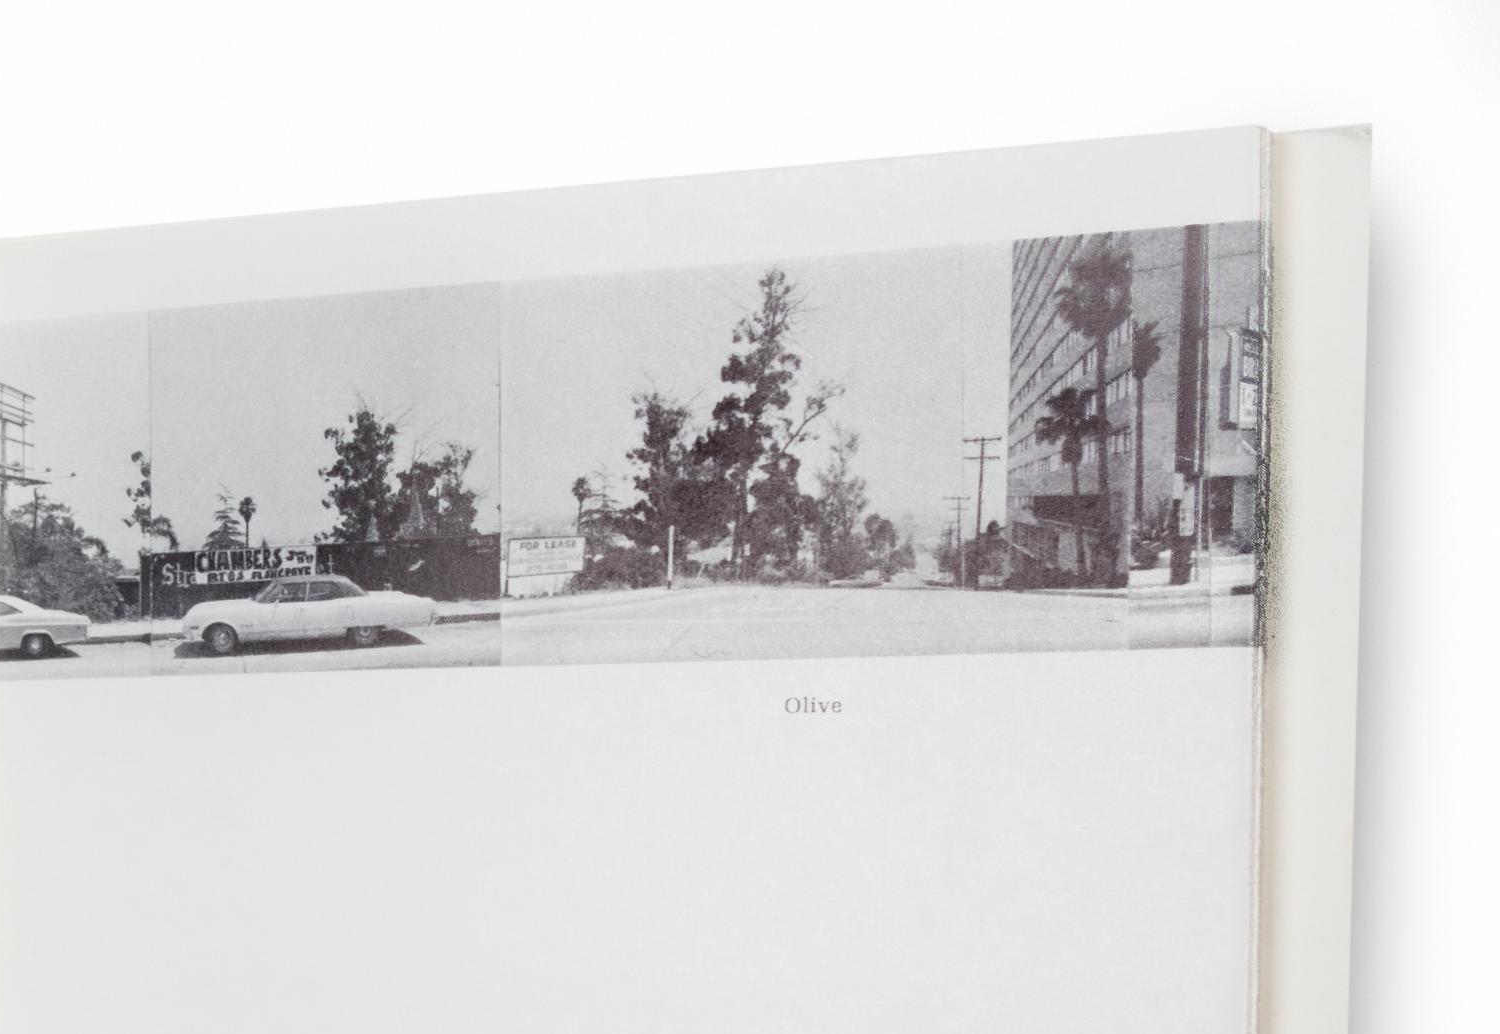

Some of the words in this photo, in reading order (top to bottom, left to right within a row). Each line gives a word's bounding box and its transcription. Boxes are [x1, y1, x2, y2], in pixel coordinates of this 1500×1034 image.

[520, 542, 540, 551] FOR
[544, 540, 577, 550] LEASE
[196, 548, 283, 573] CHAMBERS
[784, 696, 842, 714] Olive
